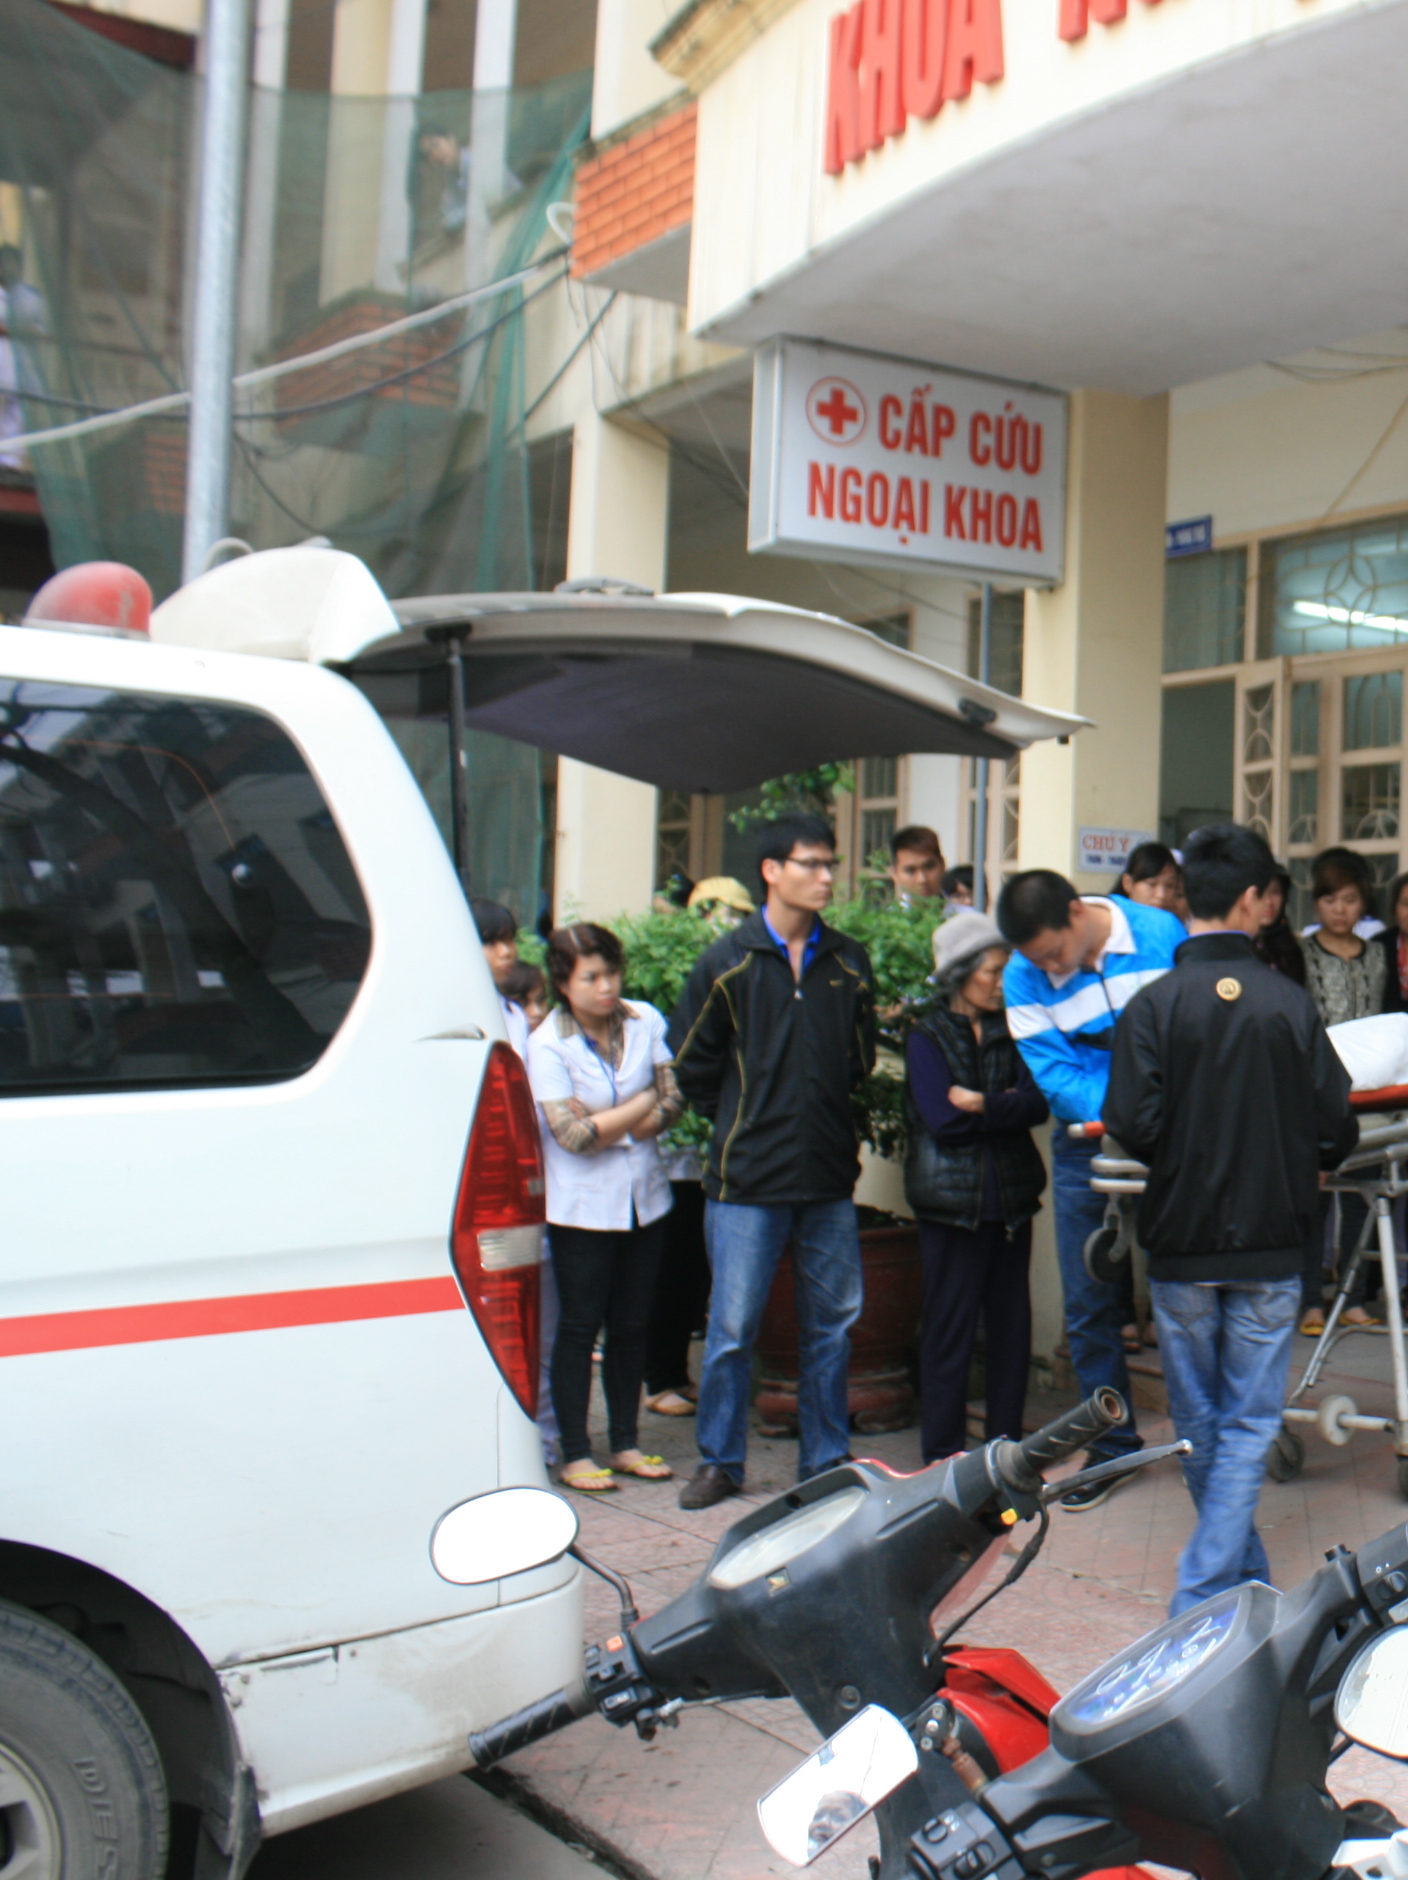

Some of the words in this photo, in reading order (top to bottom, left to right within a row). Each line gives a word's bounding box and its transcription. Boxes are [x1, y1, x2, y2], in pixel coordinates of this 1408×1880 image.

[878, 383, 957, 459] CẤP
[968, 400, 1044, 477] CỨU
[807, 460, 931, 546] NGOẠI
[943, 483, 1044, 553] KHOA
